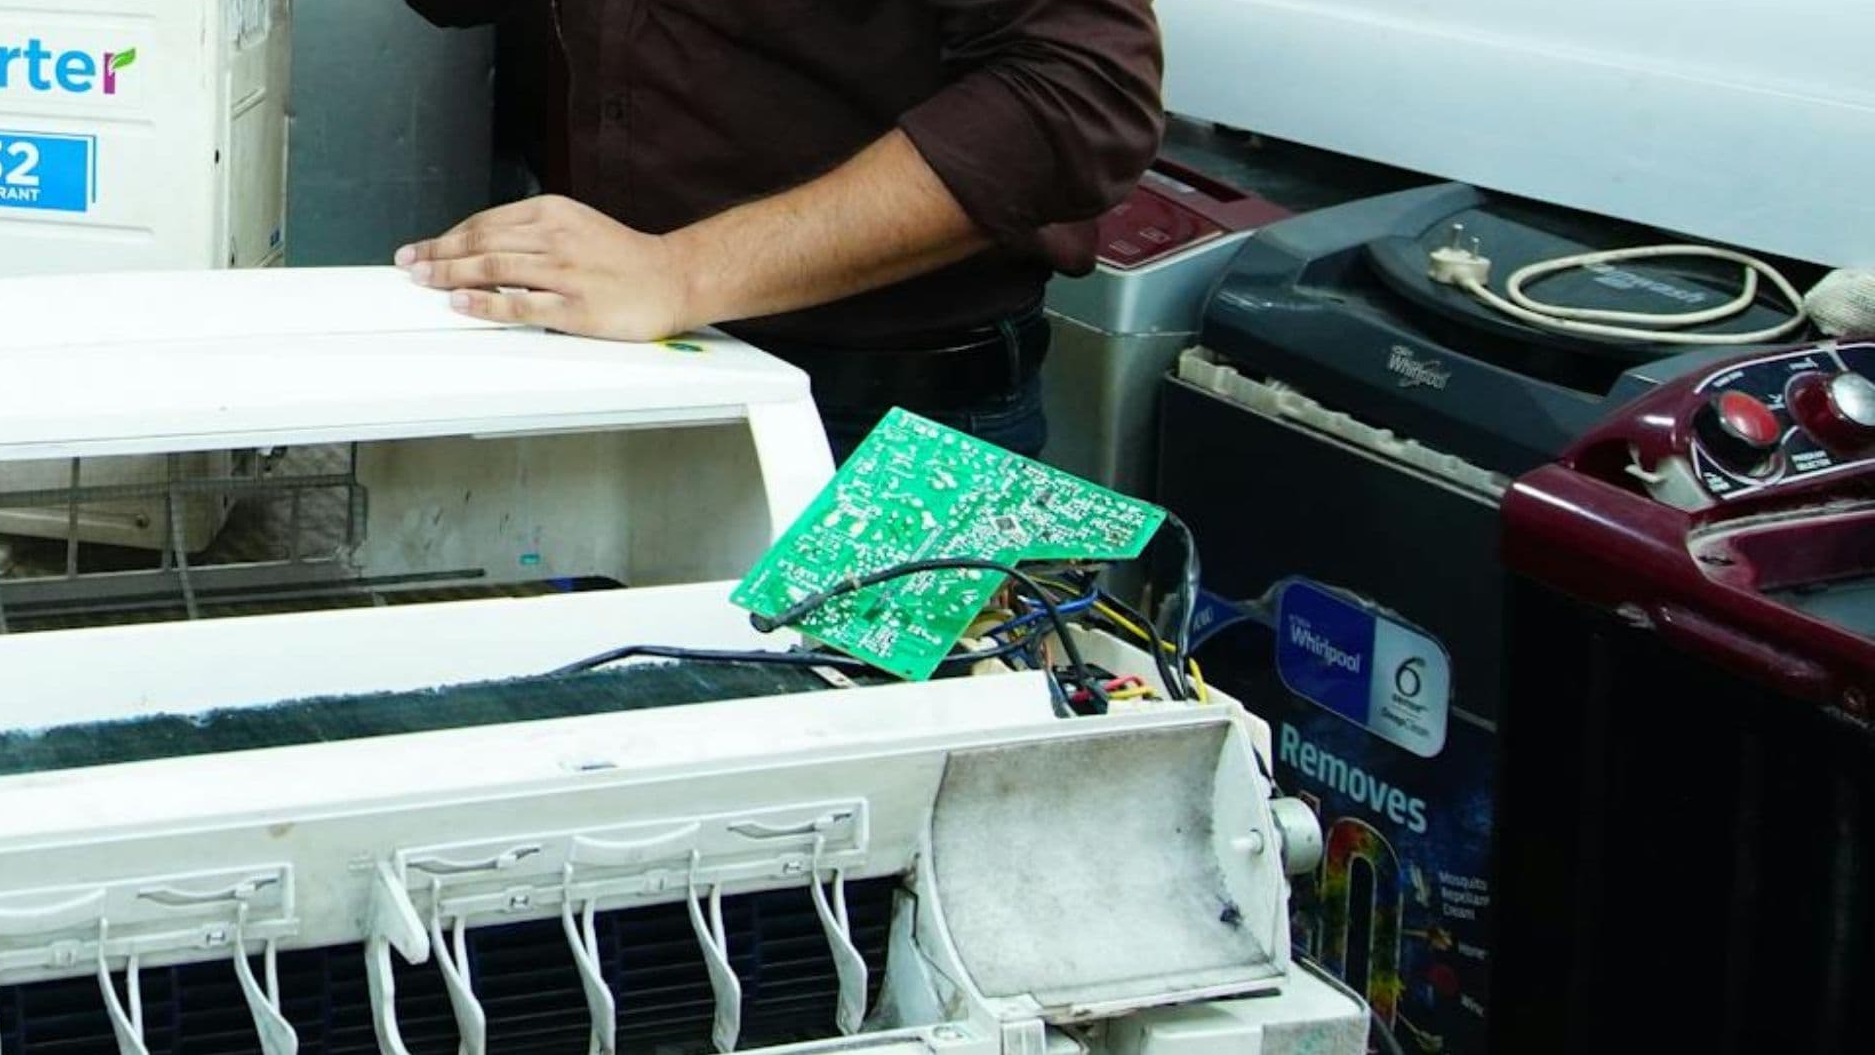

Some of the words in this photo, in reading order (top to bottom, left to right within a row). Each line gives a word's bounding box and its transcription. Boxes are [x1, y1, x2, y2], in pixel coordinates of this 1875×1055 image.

[1388, 352, 1450, 391] Whirlpool
[1289, 623, 1361, 674] Whirlpool
[1279, 721, 1429, 834] Removes
